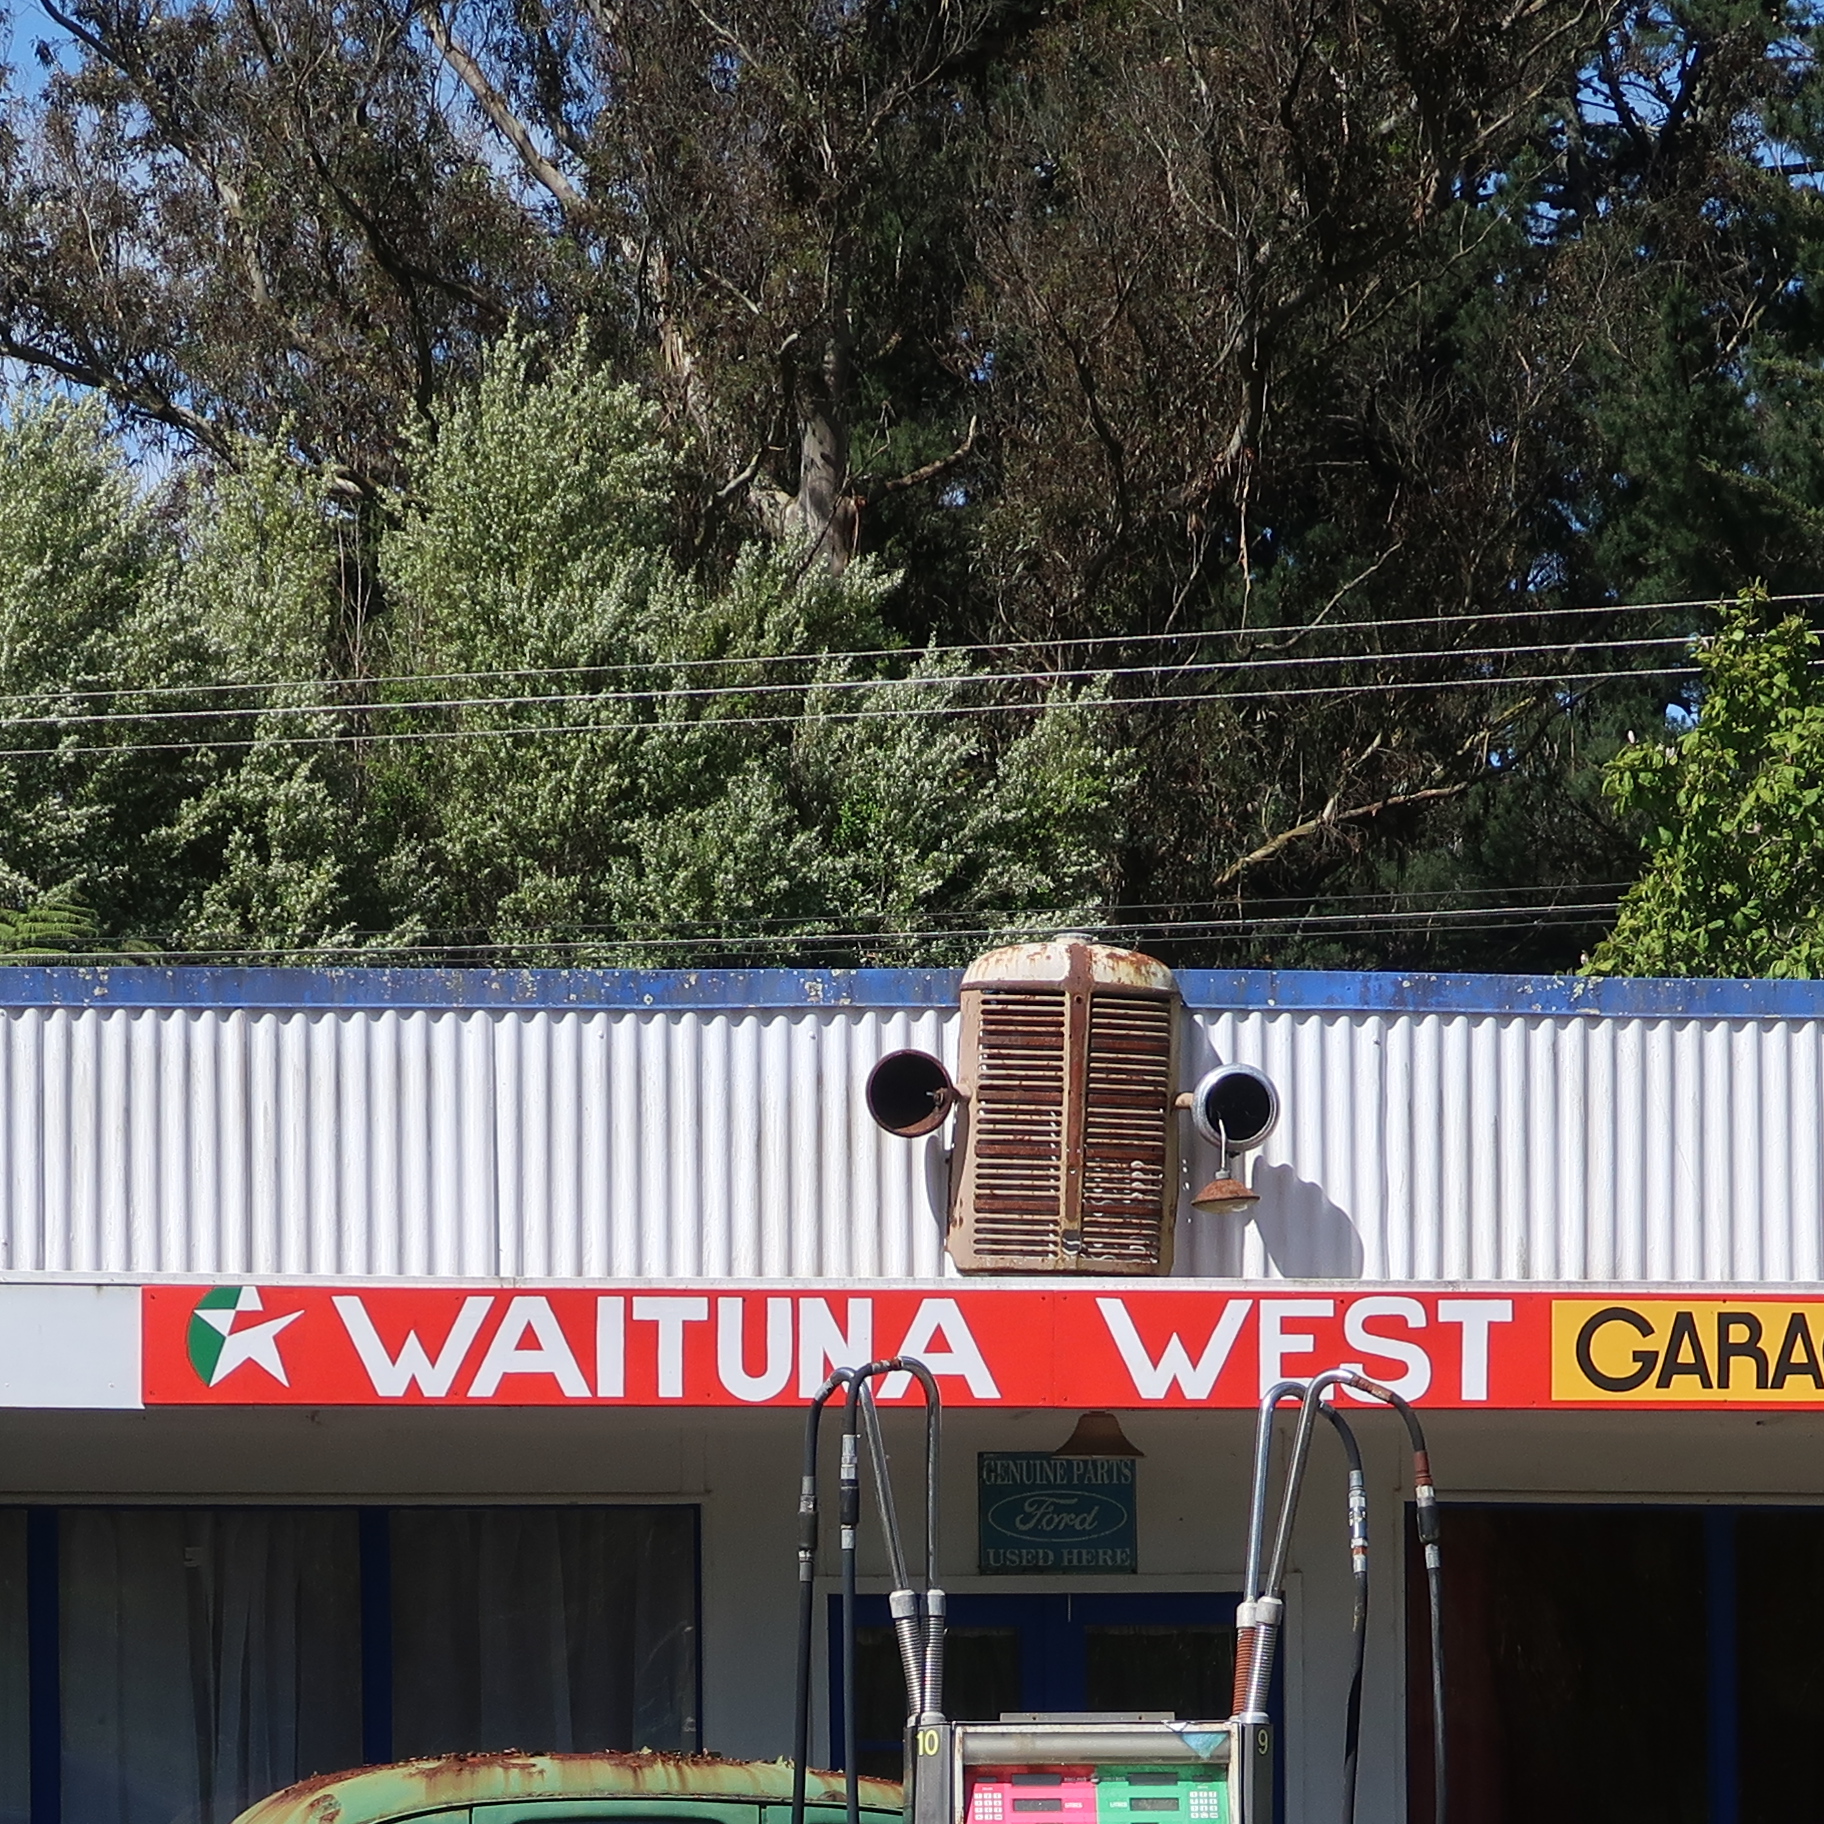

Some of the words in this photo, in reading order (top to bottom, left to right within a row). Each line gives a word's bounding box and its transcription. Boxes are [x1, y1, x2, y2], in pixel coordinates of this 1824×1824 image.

[331, 1295, 1001, 1402] WAITUNA
[1095, 1295, 1514, 1404] WEST
[982, 1459, 1067, 1485] GENUINE
[1071, 1458, 1132, 1485] PARTS
[1015, 1496, 1100, 1531] Ford
[987, 1548, 1054, 1566] USED
[1061, 1548, 1131, 1567] HERE
[916, 1729, 939, 1756] 10
[1257, 1729, 1268, 1755] 9
